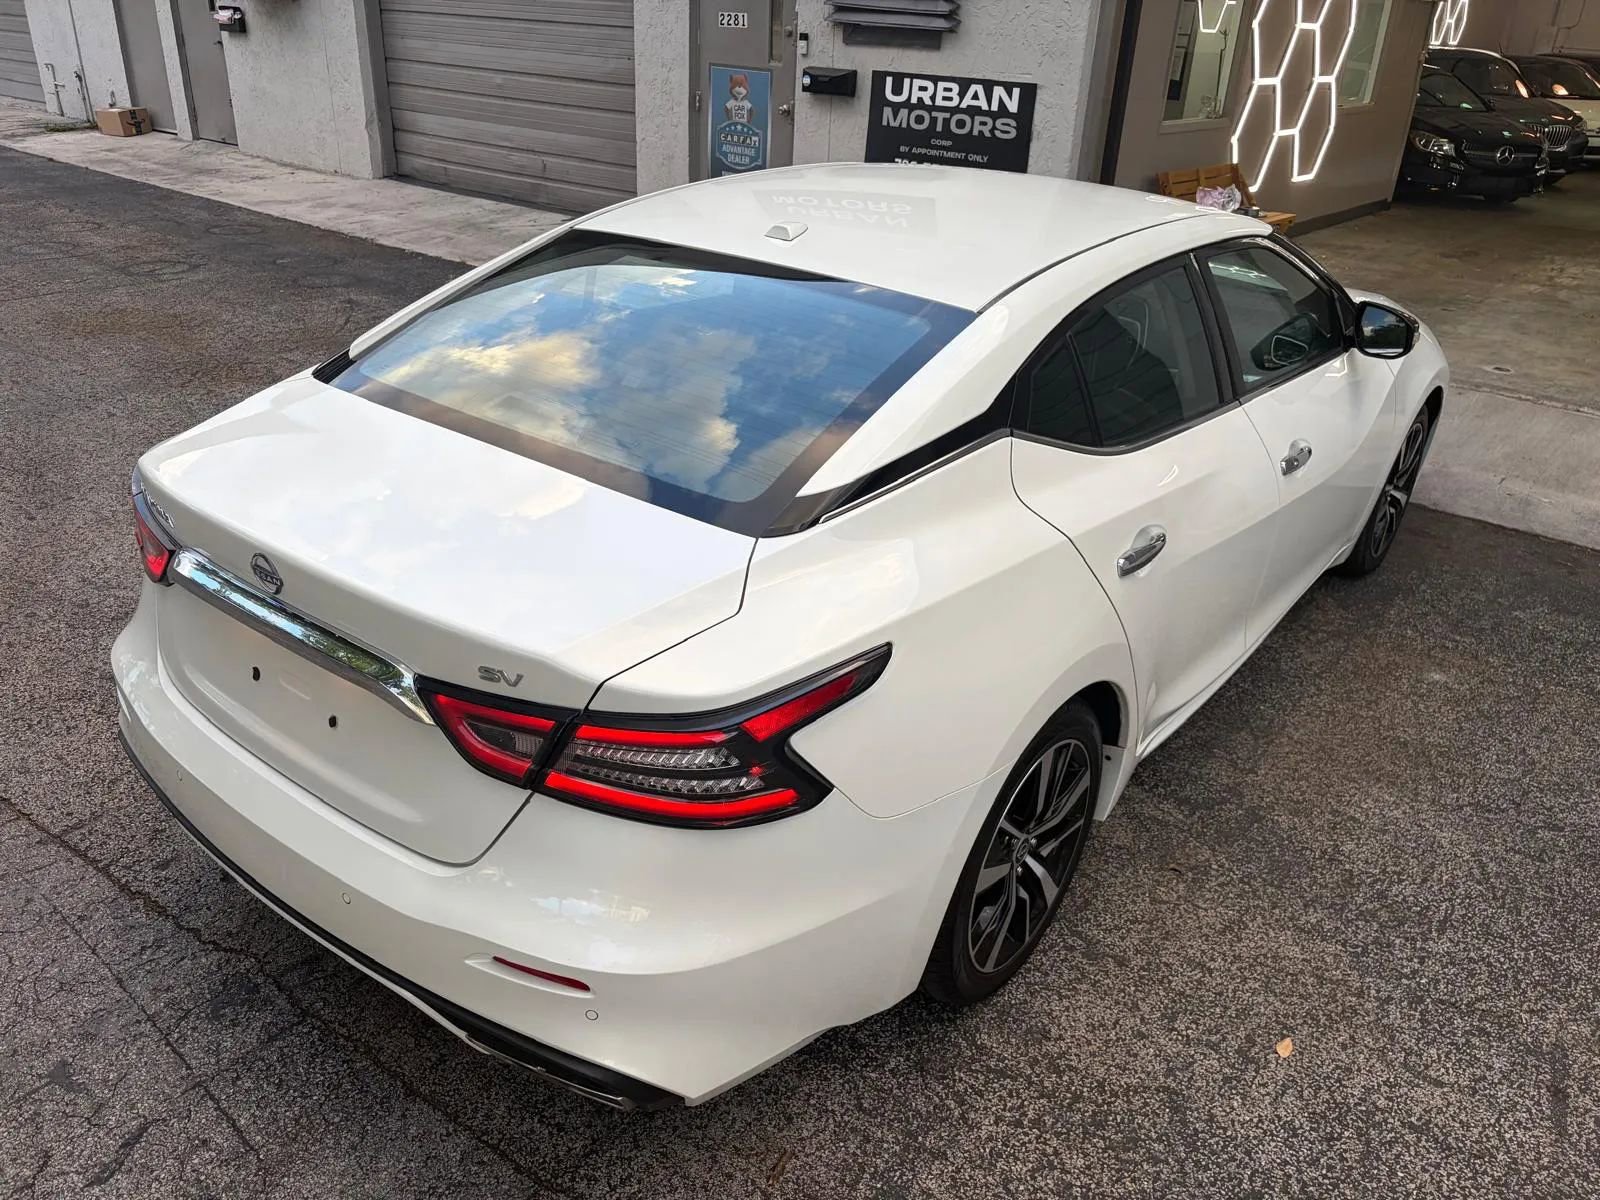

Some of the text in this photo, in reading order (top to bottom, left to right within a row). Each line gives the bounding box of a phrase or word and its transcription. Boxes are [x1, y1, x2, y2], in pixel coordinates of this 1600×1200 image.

[719, 13, 746, 27] 2281
[884, 76, 1021, 113] URBAN
[733, 104, 746, 113] CAR
[734, 112, 746, 120] FOX
[881, 106, 1018, 140] MOTORS
[720, 132, 759, 147] CARFAX
[930, 138, 953, 147] CORP
[722, 144, 756, 157] ADVANTAGE
[899, 145, 989, 163] BY APPOINTMENT ONLY
[727, 153, 750, 164] DEALER
[478, 665, 524, 688] SV
